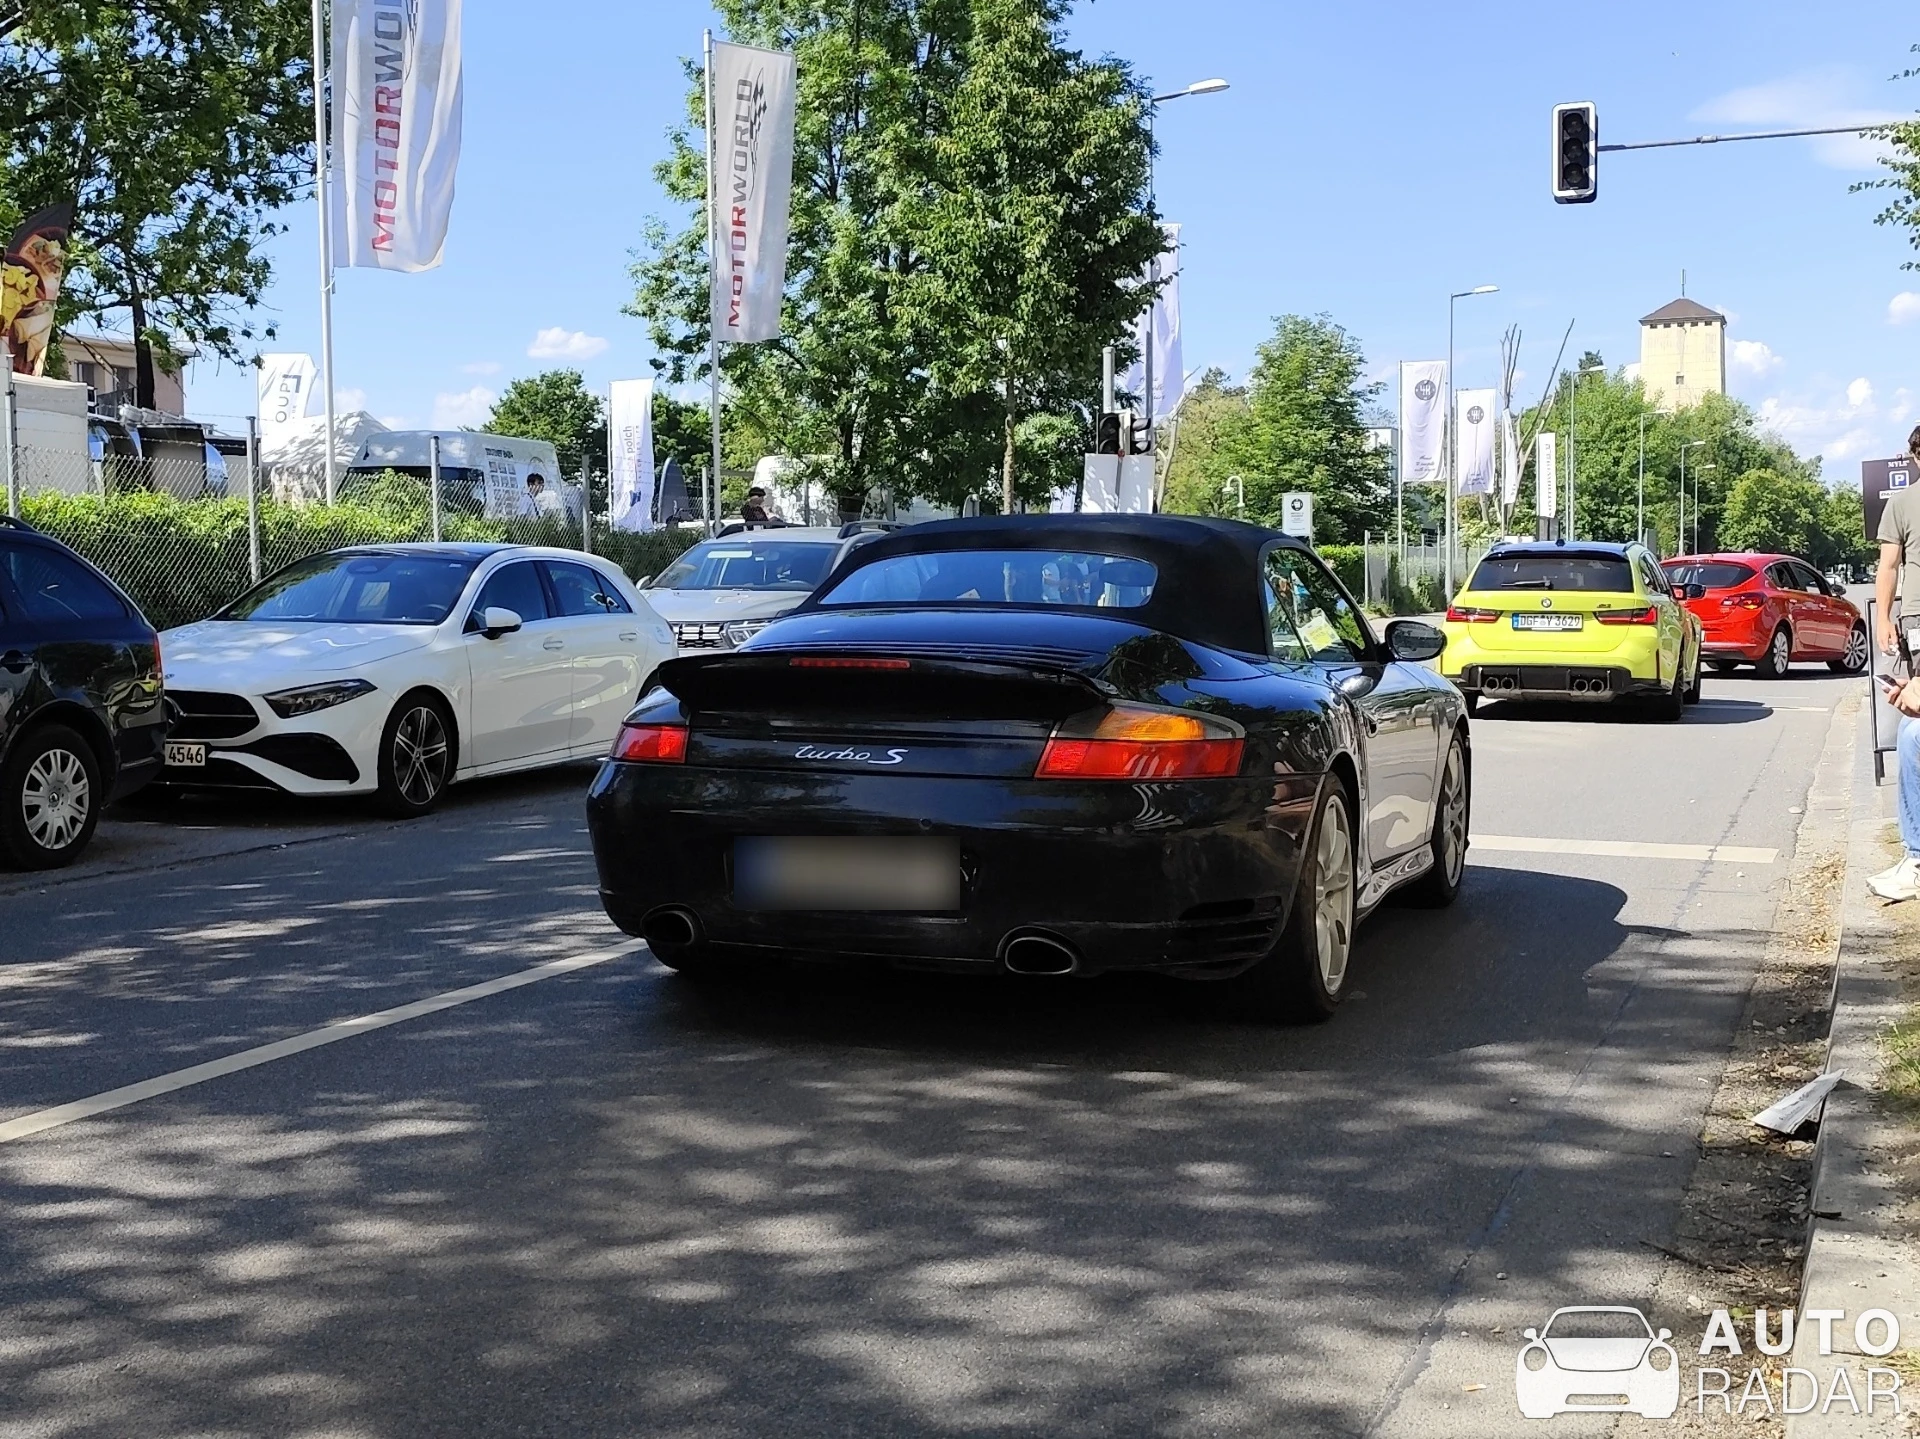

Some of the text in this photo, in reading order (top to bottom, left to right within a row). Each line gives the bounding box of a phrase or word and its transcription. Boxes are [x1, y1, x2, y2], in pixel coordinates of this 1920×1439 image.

[372, 0, 403, 253] MOTORWO
[728, 78, 752, 328] MOTORWORLD
[623, 425, 635, 453] polch
[1894, 474, 1905, 486] P
[1520, 615, 1539, 626] DGF
[168, 746, 203, 763] 4546
[794, 744, 909, 765] turbo S
